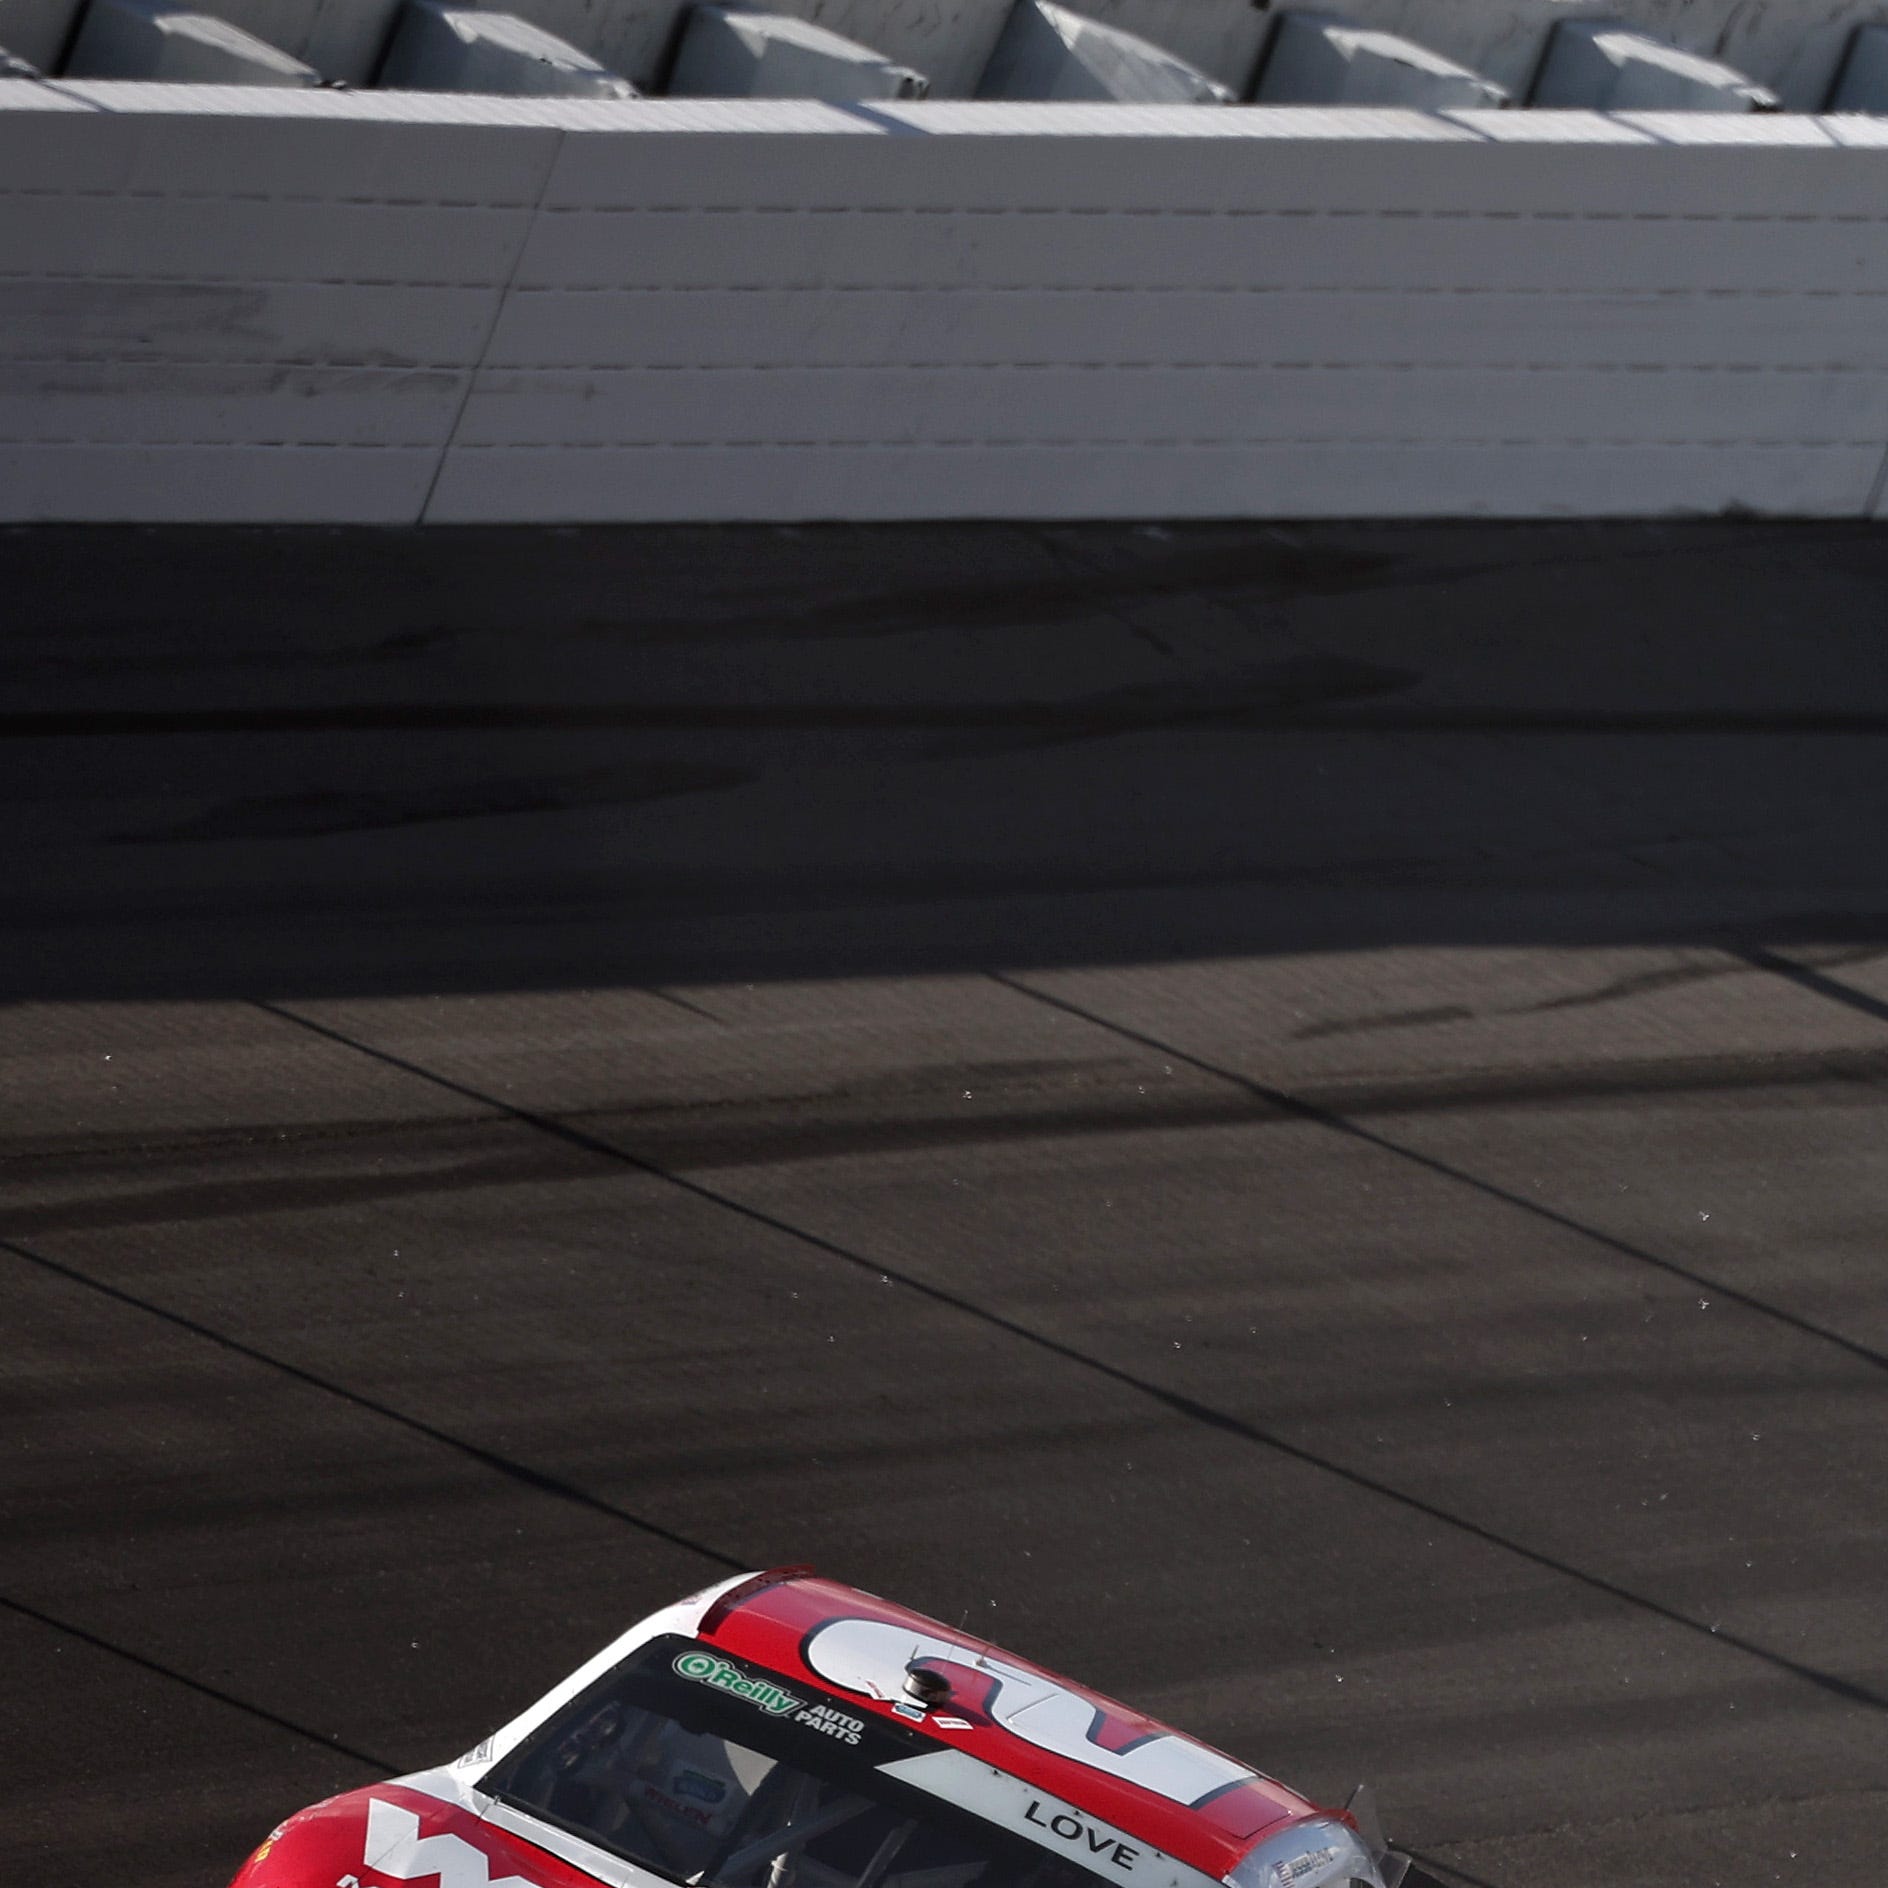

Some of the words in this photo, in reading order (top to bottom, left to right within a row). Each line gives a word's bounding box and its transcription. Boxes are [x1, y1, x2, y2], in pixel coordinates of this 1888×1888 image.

[673, 1651, 808, 1718] O'Reilly
[794, 1709, 863, 1746] PARTS
[809, 1703, 866, 1734] AUTO
[1022, 1799, 1141, 1873] LOVE
